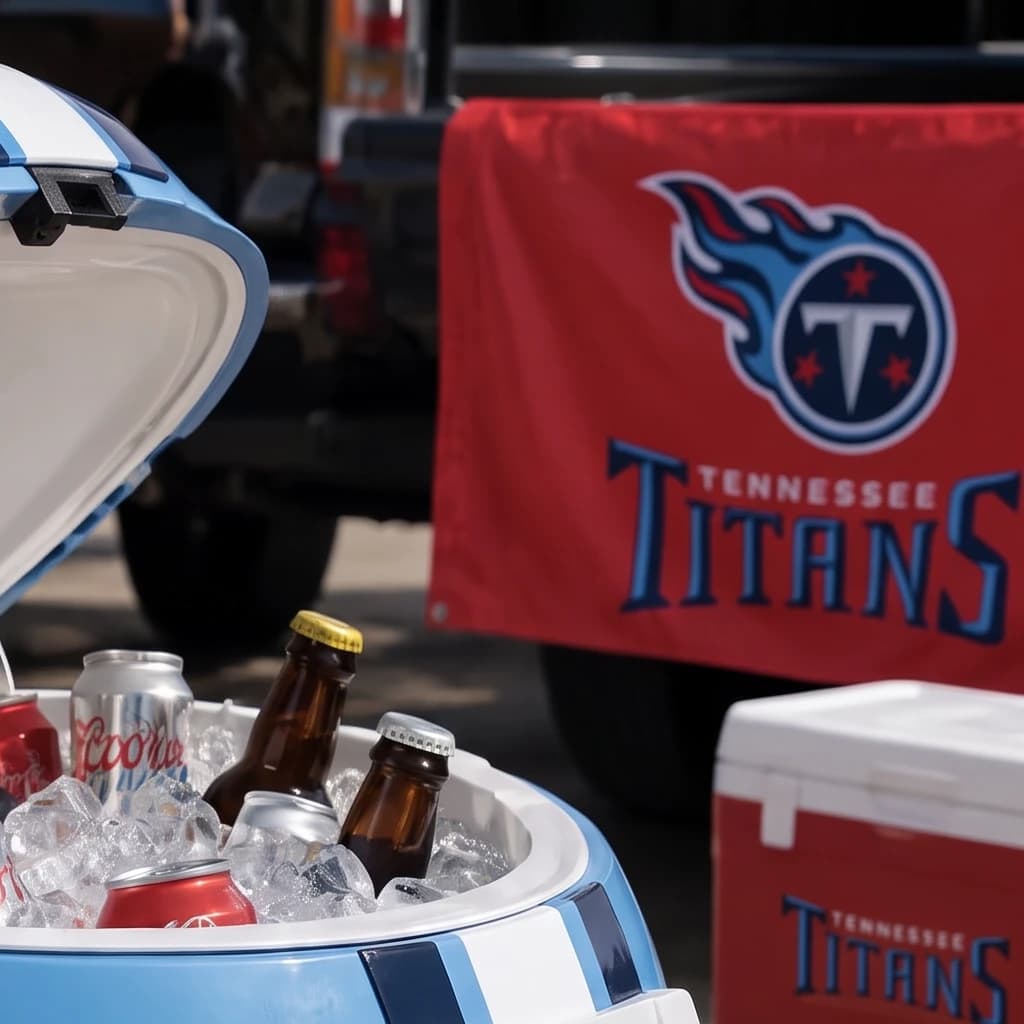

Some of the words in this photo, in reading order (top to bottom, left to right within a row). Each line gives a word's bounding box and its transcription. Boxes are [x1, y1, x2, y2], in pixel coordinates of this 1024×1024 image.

[799, 302, 916, 416] T
[697, 464, 937, 510] TENNESSEE
[607, 436, 1022, 647] TITANS
[831, 909, 965, 952] TENNESSEE
